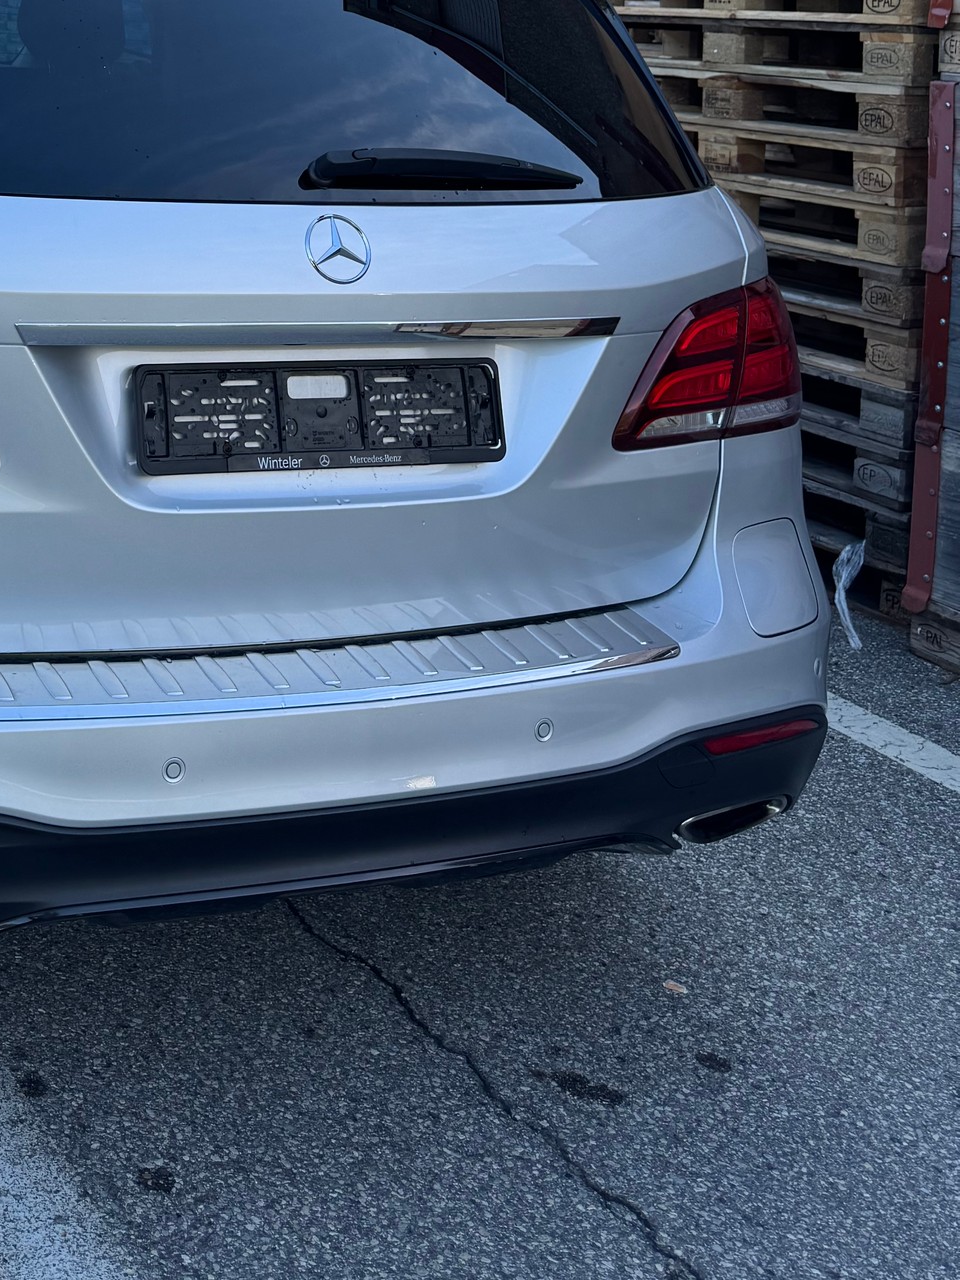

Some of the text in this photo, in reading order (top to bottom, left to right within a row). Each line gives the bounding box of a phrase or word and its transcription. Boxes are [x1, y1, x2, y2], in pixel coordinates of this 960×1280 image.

[870, 52, 895, 65] EPAL
[864, 112, 888, 129] EPAL
[862, 171, 887, 189] EPAL
[257, 453, 402, 469] Winteler Mercedes-Benz
